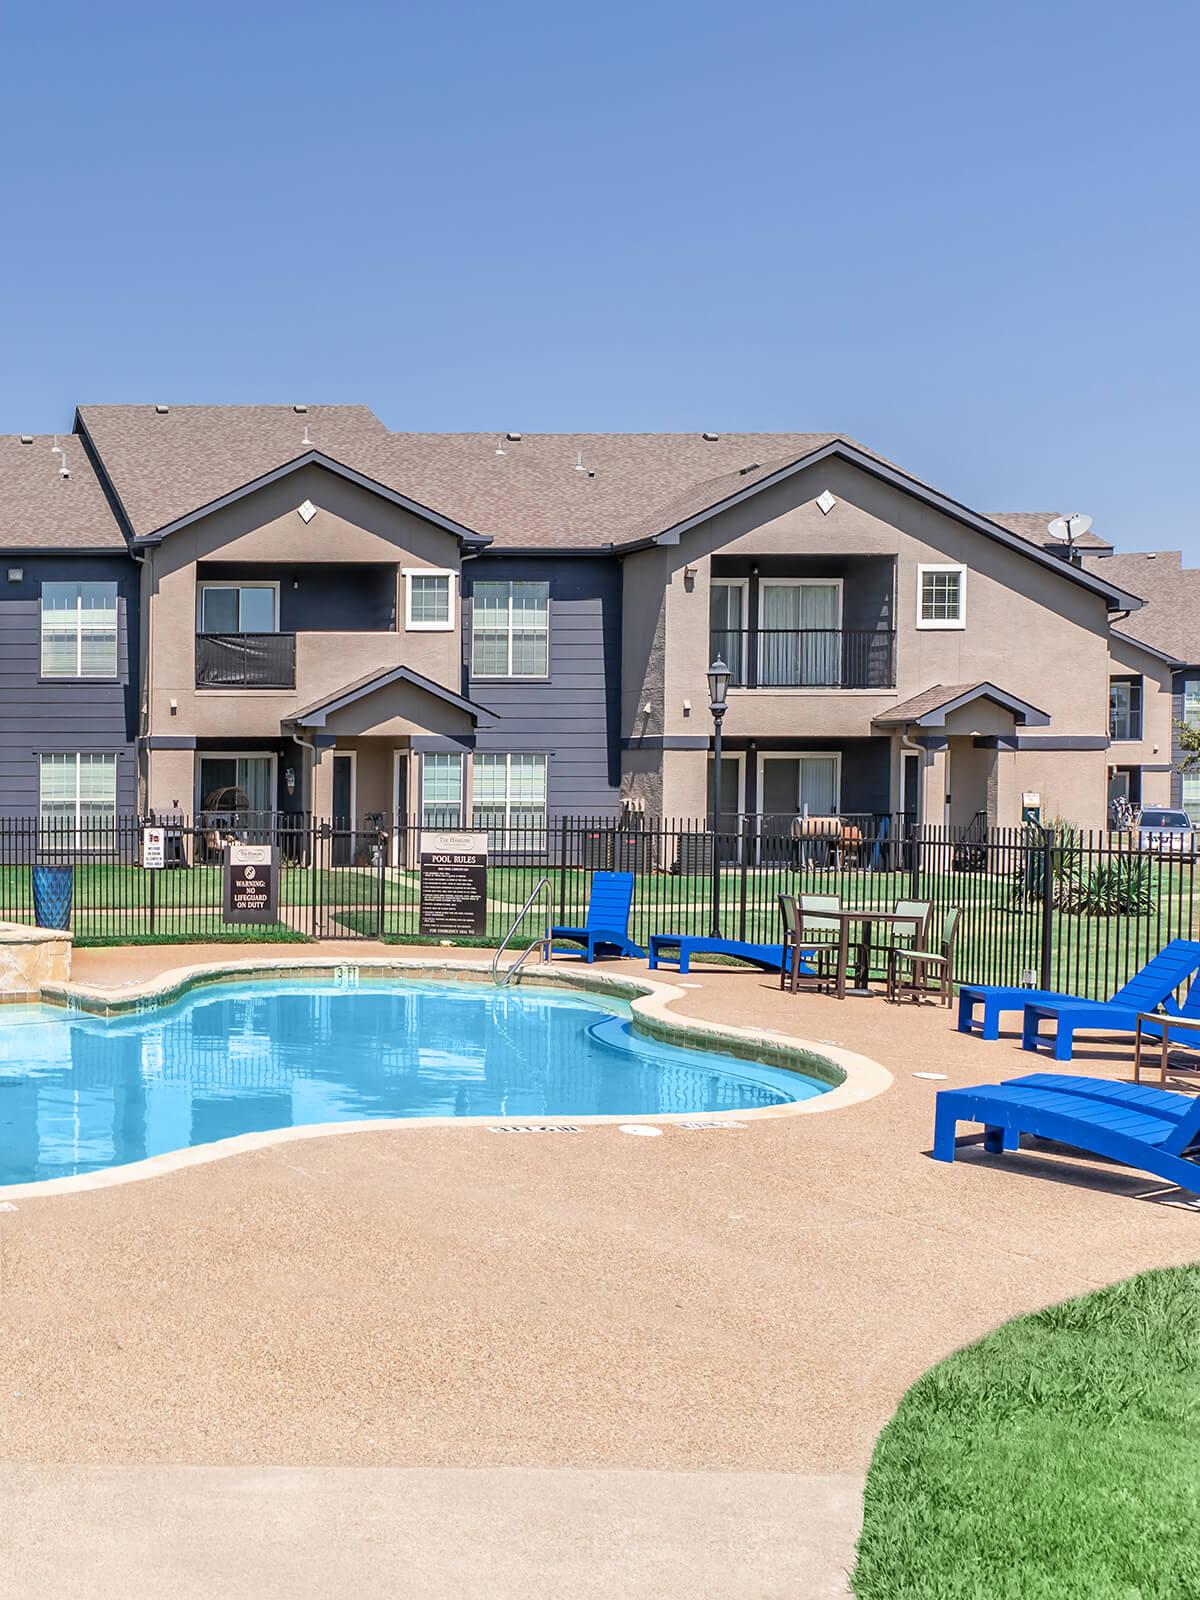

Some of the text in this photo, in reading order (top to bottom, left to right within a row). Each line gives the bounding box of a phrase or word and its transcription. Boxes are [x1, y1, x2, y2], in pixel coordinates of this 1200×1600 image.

[432, 855, 476, 864] POOL RULES
[247, 901, 265, 909] DUTY
[337, 967, 343, 978] 3
